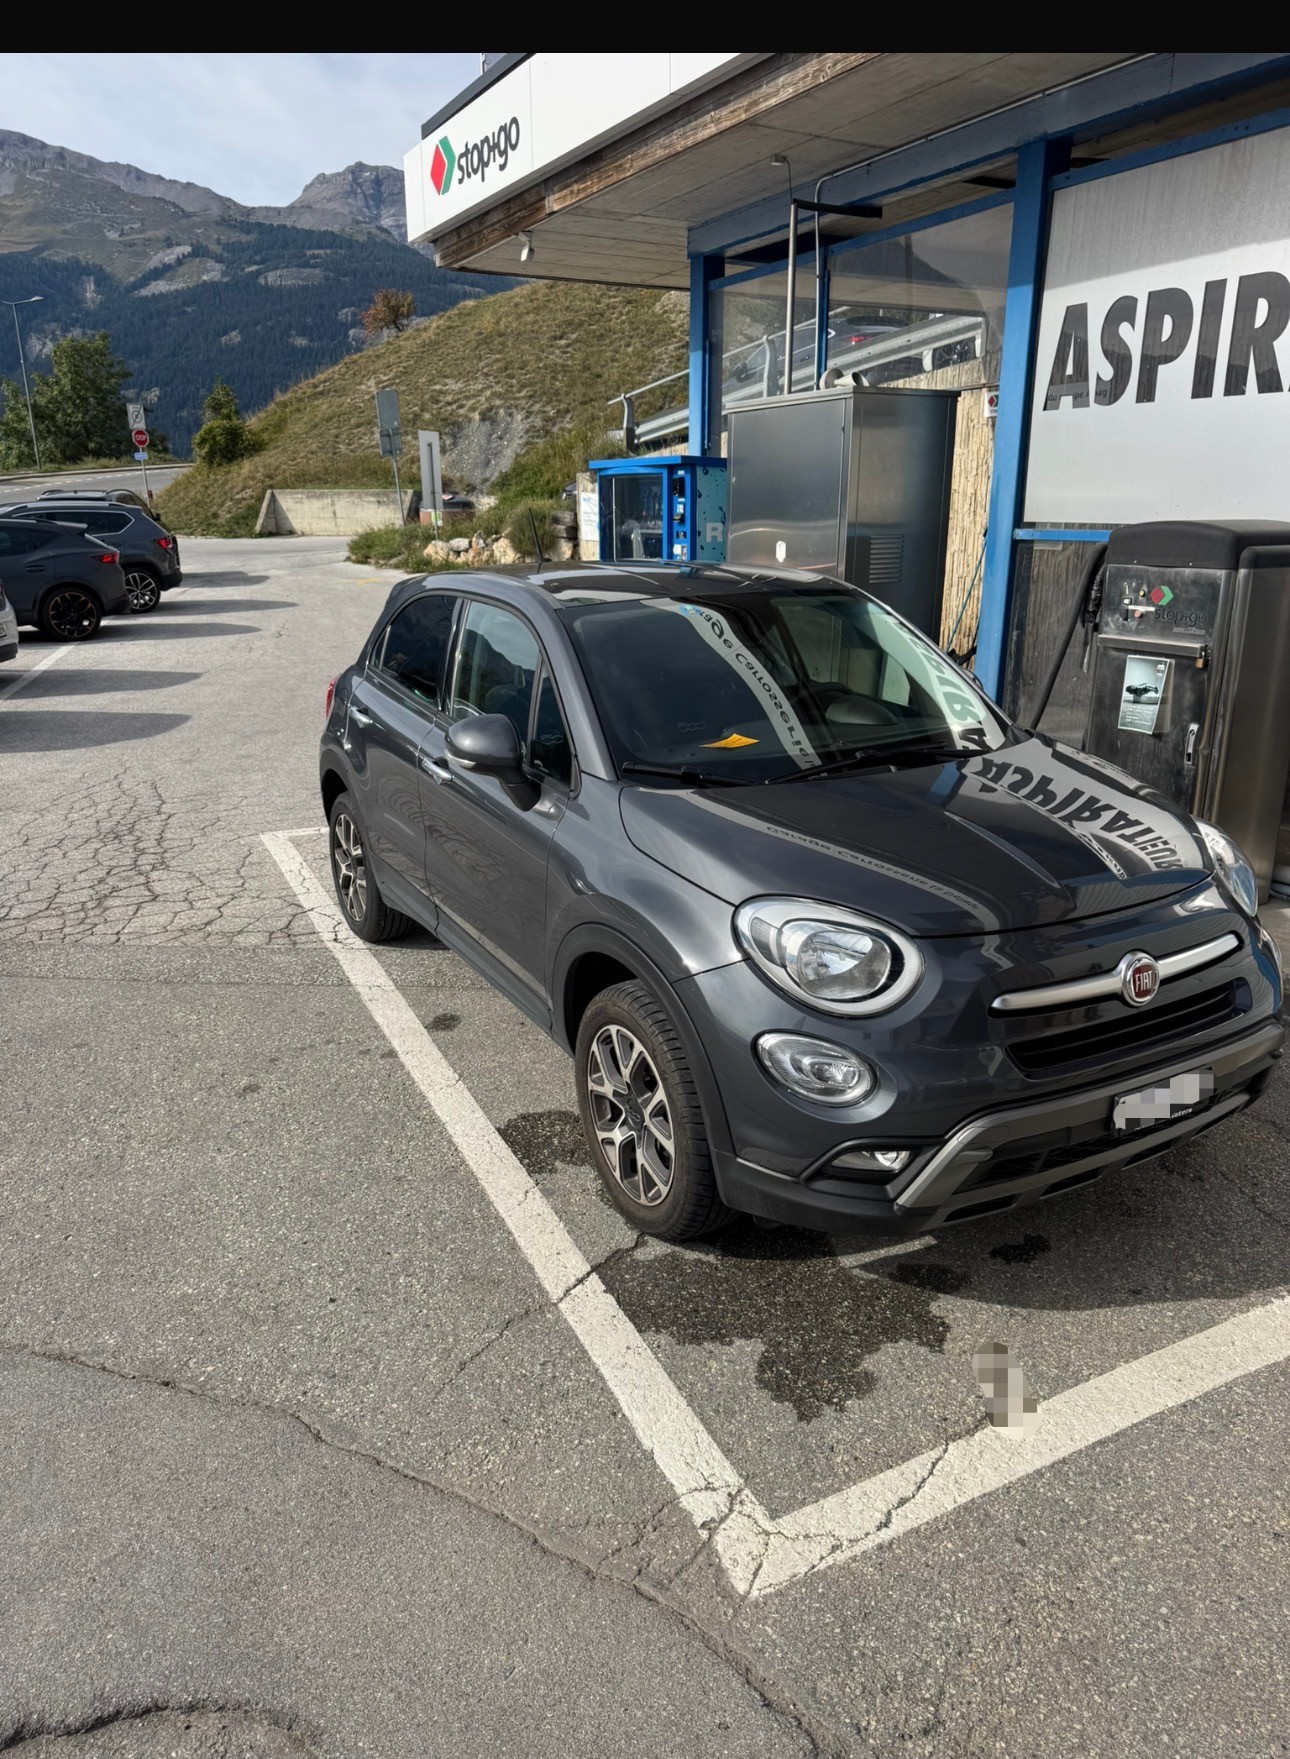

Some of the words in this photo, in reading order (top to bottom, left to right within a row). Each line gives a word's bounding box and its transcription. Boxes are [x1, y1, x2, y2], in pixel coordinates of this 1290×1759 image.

[457, 116, 520, 185] stop+go
[1043, 270, 1290, 411] ASPIR
[1154, 608, 1208, 627] stop+go
[1135, 970, 1153, 992] FIAT
